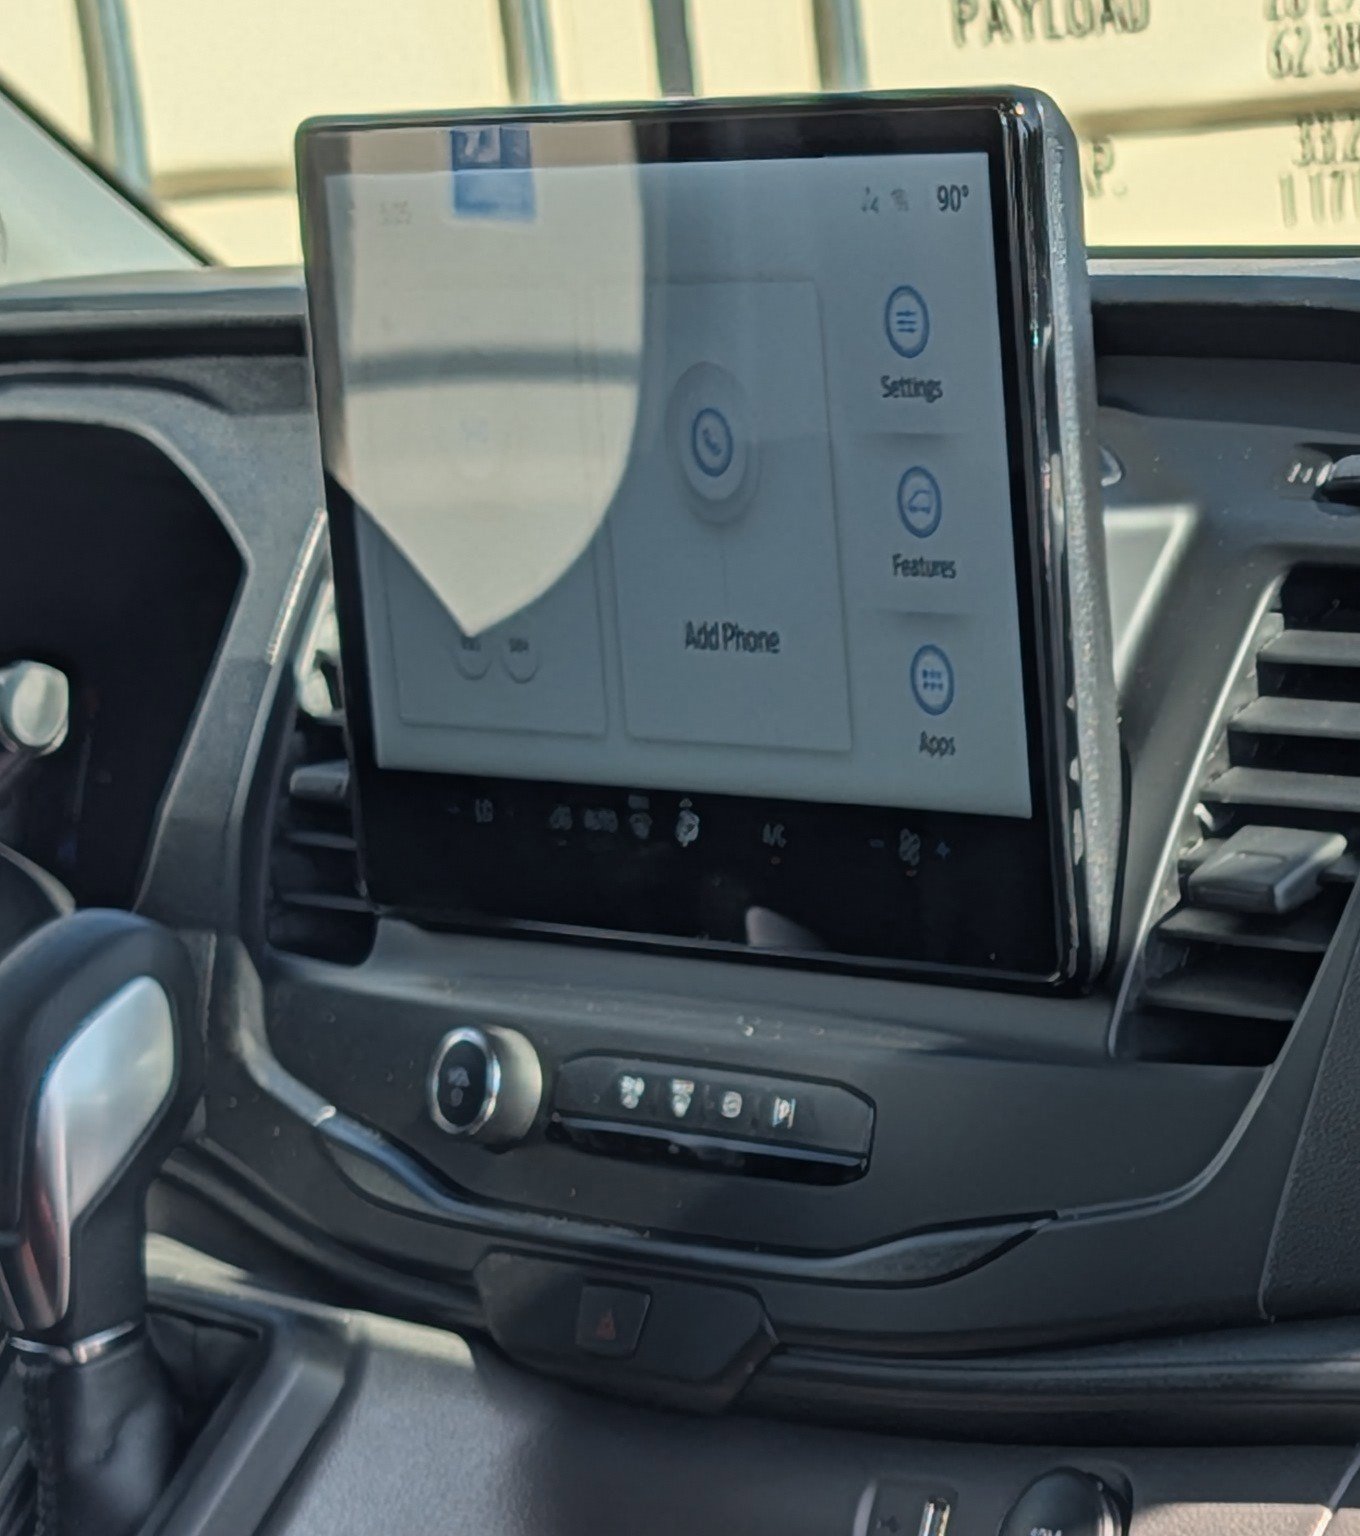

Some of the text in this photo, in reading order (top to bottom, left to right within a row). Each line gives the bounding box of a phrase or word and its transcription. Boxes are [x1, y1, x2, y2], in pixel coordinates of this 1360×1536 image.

[952, 0, 1150, 48] PAYLOAD
[937, 184, 970, 213] 90°
[880, 375, 944, 403] Settings
[892, 553, 957, 580] Features
[685, 621, 781, 654] Add Phone
[919, 730, 956, 757] Apps
